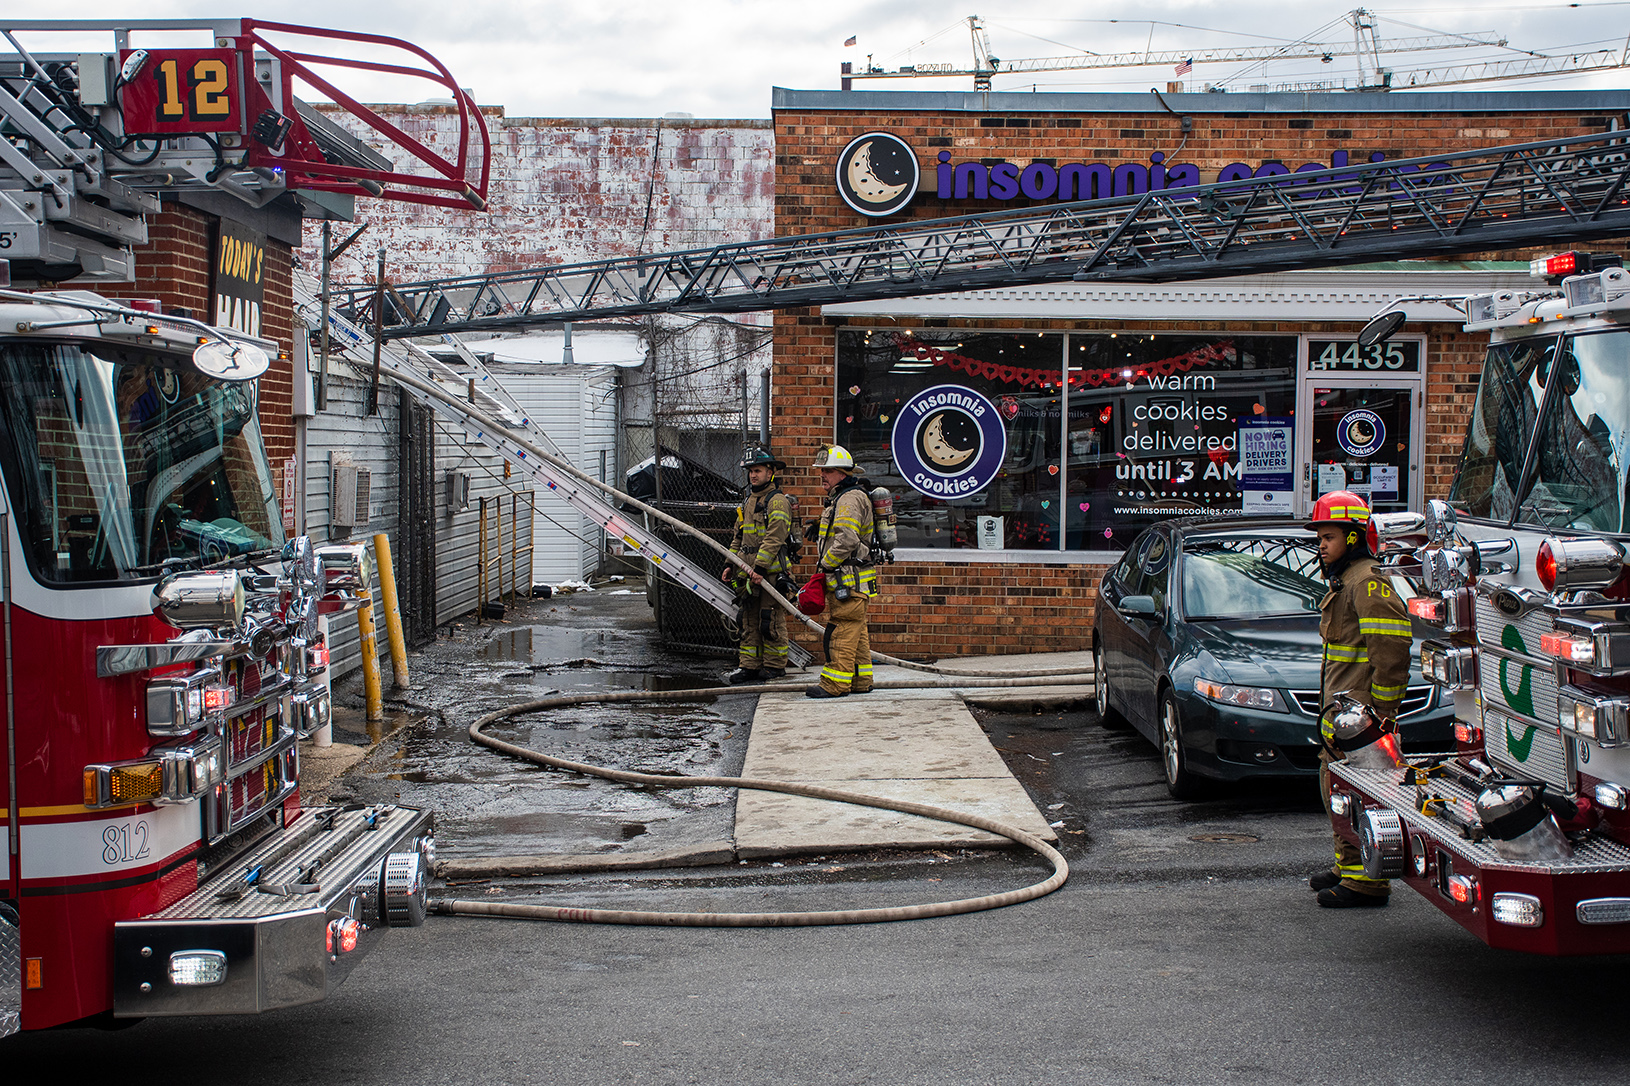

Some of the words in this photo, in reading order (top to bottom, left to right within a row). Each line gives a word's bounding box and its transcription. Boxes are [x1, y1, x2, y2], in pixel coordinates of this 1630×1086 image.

[155, 58, 231, 122] 12
[936, 150, 1201, 200] insomnia
[219, 235, 264, 285] TODAY'S
[1319, 342, 1405, 369] 4435
[1147, 375, 1215, 390] warm
[910, 392, 986, 417] insomnia
[1133, 400, 1228, 420] cookies
[1344, 411, 1377, 423] insomnia
[1123, 430, 1237, 451] delivered
[1245, 431, 1273, 441] NOW
[1245, 440, 1287, 451] HIRING
[745, 451, 752, 460] 11
[1245, 450, 1287, 459] DELIVERY
[1346, 445, 1375, 455] cookies
[1115, 460, 1171, 480] until
[1180, 461, 1194, 480] 3
[1203, 461, 1243, 480] AM
[1246, 458, 1287, 467] DRIVERS
[914, 472, 979, 494] cookies
[1113, 506, 1243, 515] www.insomniacookies.com
[102, 820, 151, 865] 812
